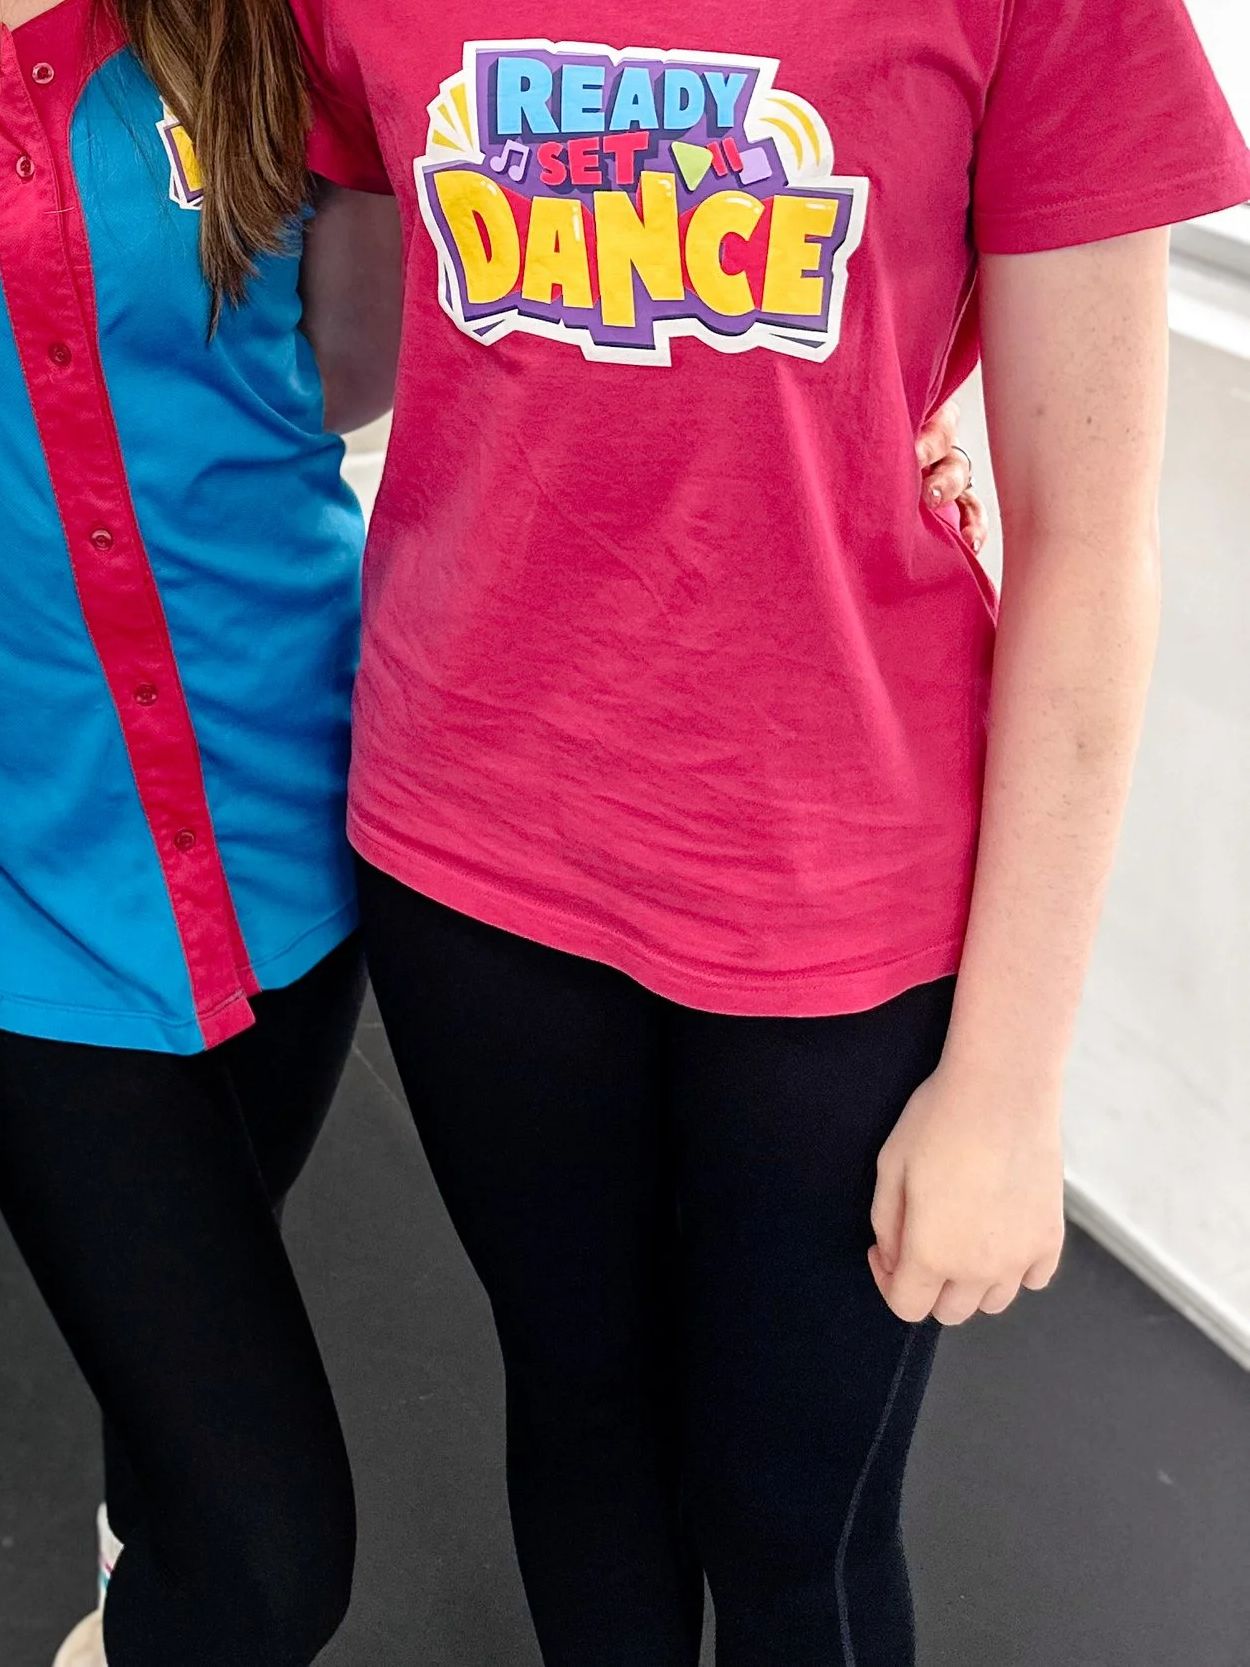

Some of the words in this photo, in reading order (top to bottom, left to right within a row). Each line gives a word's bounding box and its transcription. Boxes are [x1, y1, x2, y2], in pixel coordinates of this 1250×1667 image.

[496, 57, 747, 135] READY
[537, 131, 649, 185] SET
[434, 170, 839, 327] DANCE
